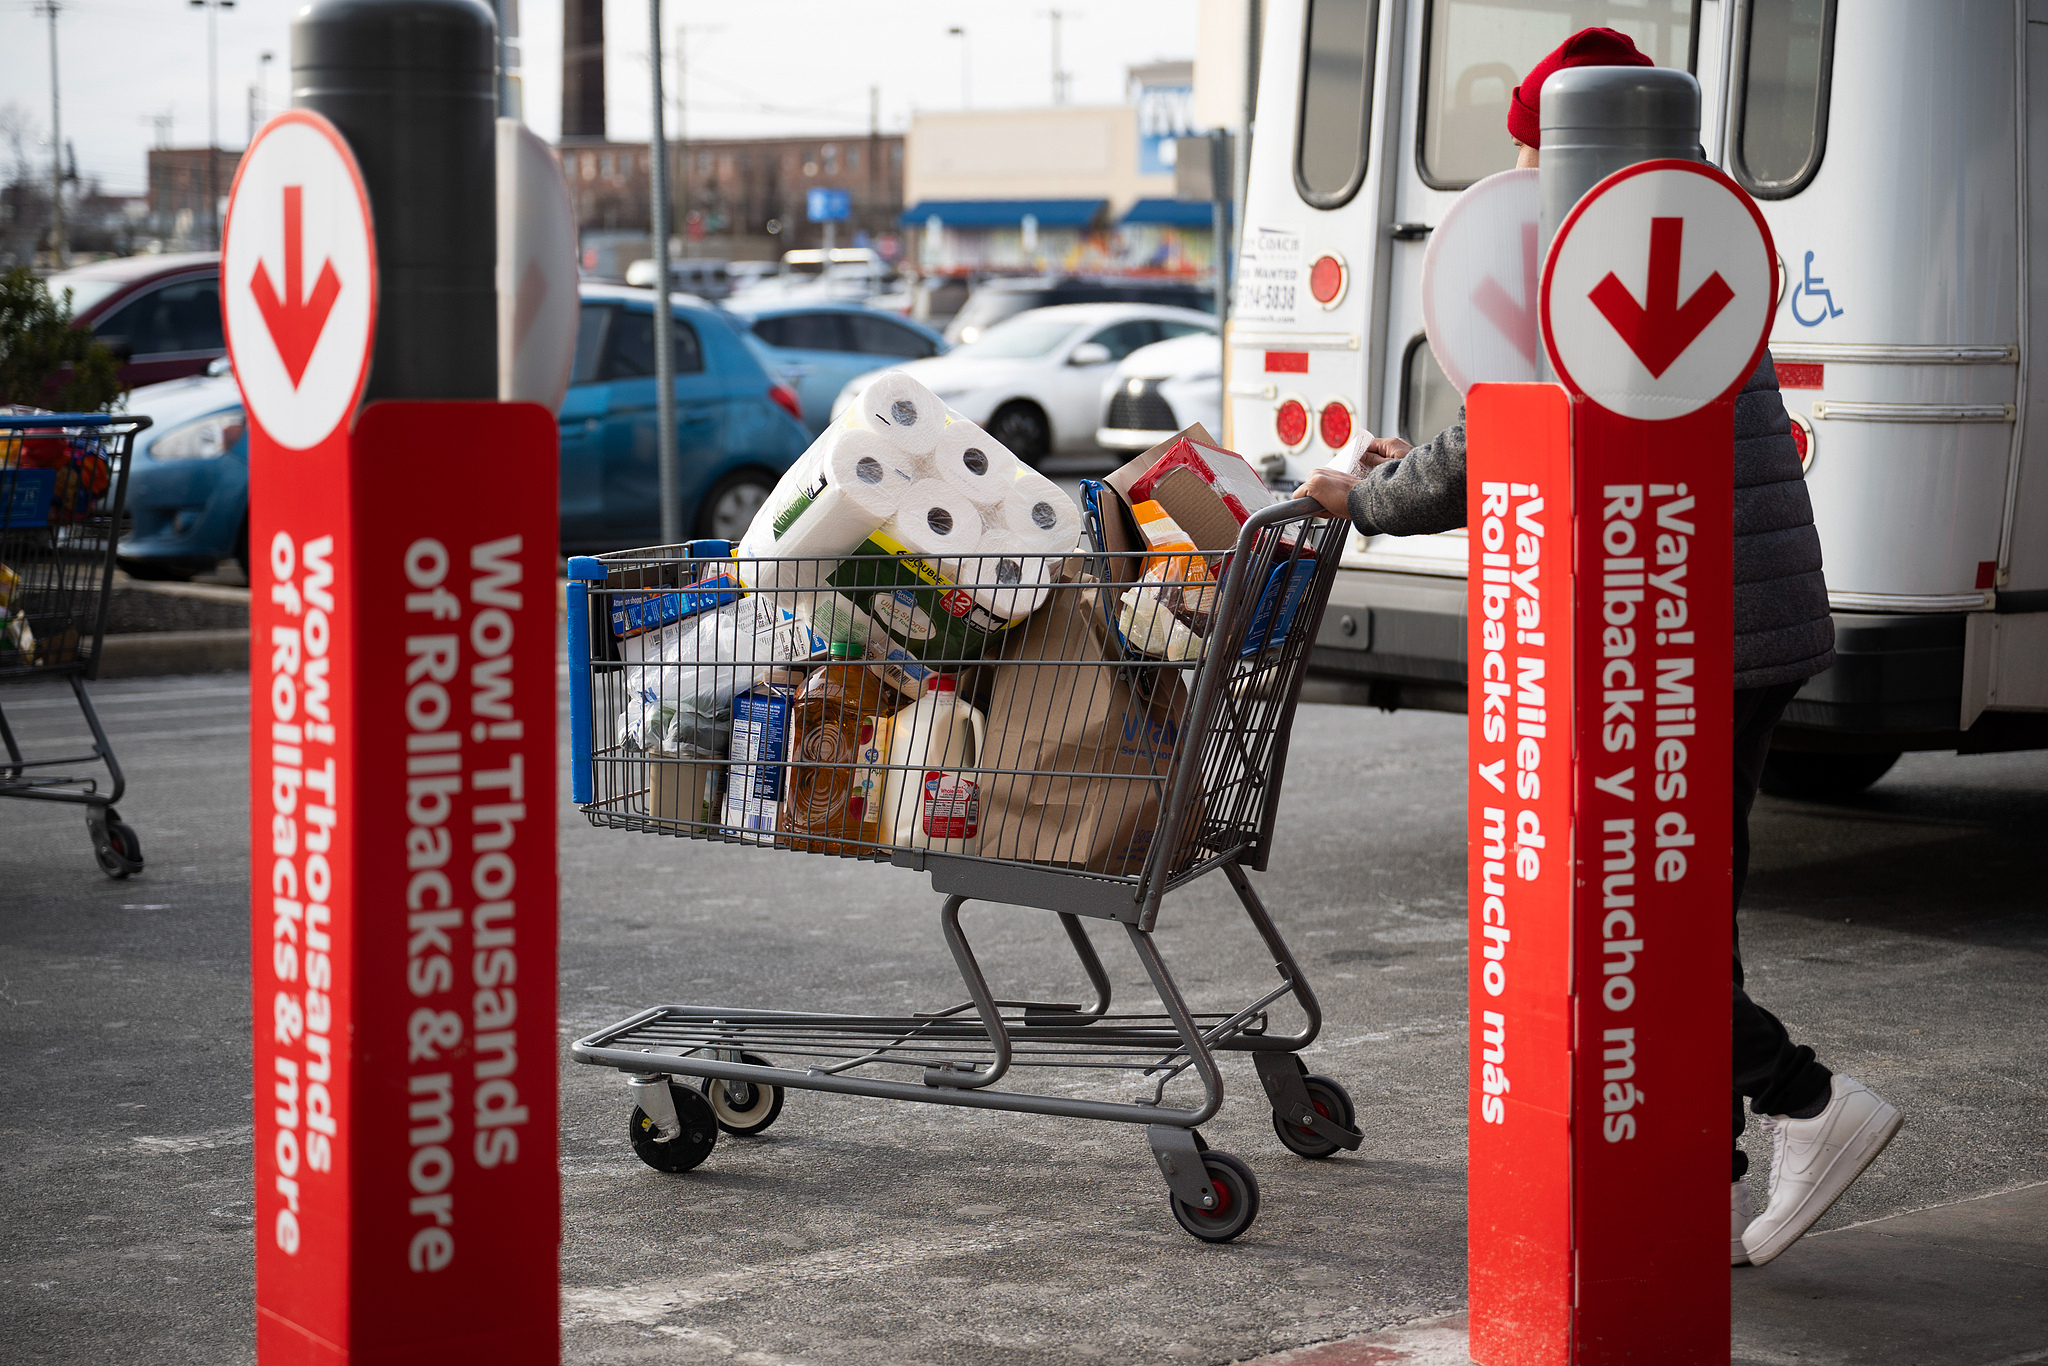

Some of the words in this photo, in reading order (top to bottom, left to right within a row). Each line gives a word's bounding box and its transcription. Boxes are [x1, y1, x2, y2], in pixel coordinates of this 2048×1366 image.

[270, 530, 302, 617] of
[302, 533, 336, 745] Wow!
[404, 536, 462, 622] of
[470, 533, 524, 743] Wow!
[1481, 481, 1511, 743] Rollbacks
[1510, 482, 1545, 647] ¡Vaya!
[1602, 484, 1645, 753] Rollbacks
[1648, 482, 1696, 646] ¡Vaya!
[271, 626, 304, 983] Rollbacks
[1478, 758, 1506, 794] y
[1516, 657, 1547, 800] Miles
[1594, 766, 1635, 802] y
[1654, 657, 1697, 802] Miles
[404, 633, 464, 998] Rollbacks
[1516, 809, 1546, 881] de
[1654, 811, 1696, 883] de
[304, 757, 337, 1174] Thousands
[470, 753, 529, 1169] Thousands
[1483, 806, 1510, 997] mucho
[1602, 818, 1644, 1012] mucho
[274, 990, 304, 1048] &
[407, 1006, 463, 1065] &
[1482, 1010, 1510, 1125] más
[1602, 1027, 1645, 1144] más
[274, 1056, 301, 1257] more
[408, 1072, 456, 1273] more
